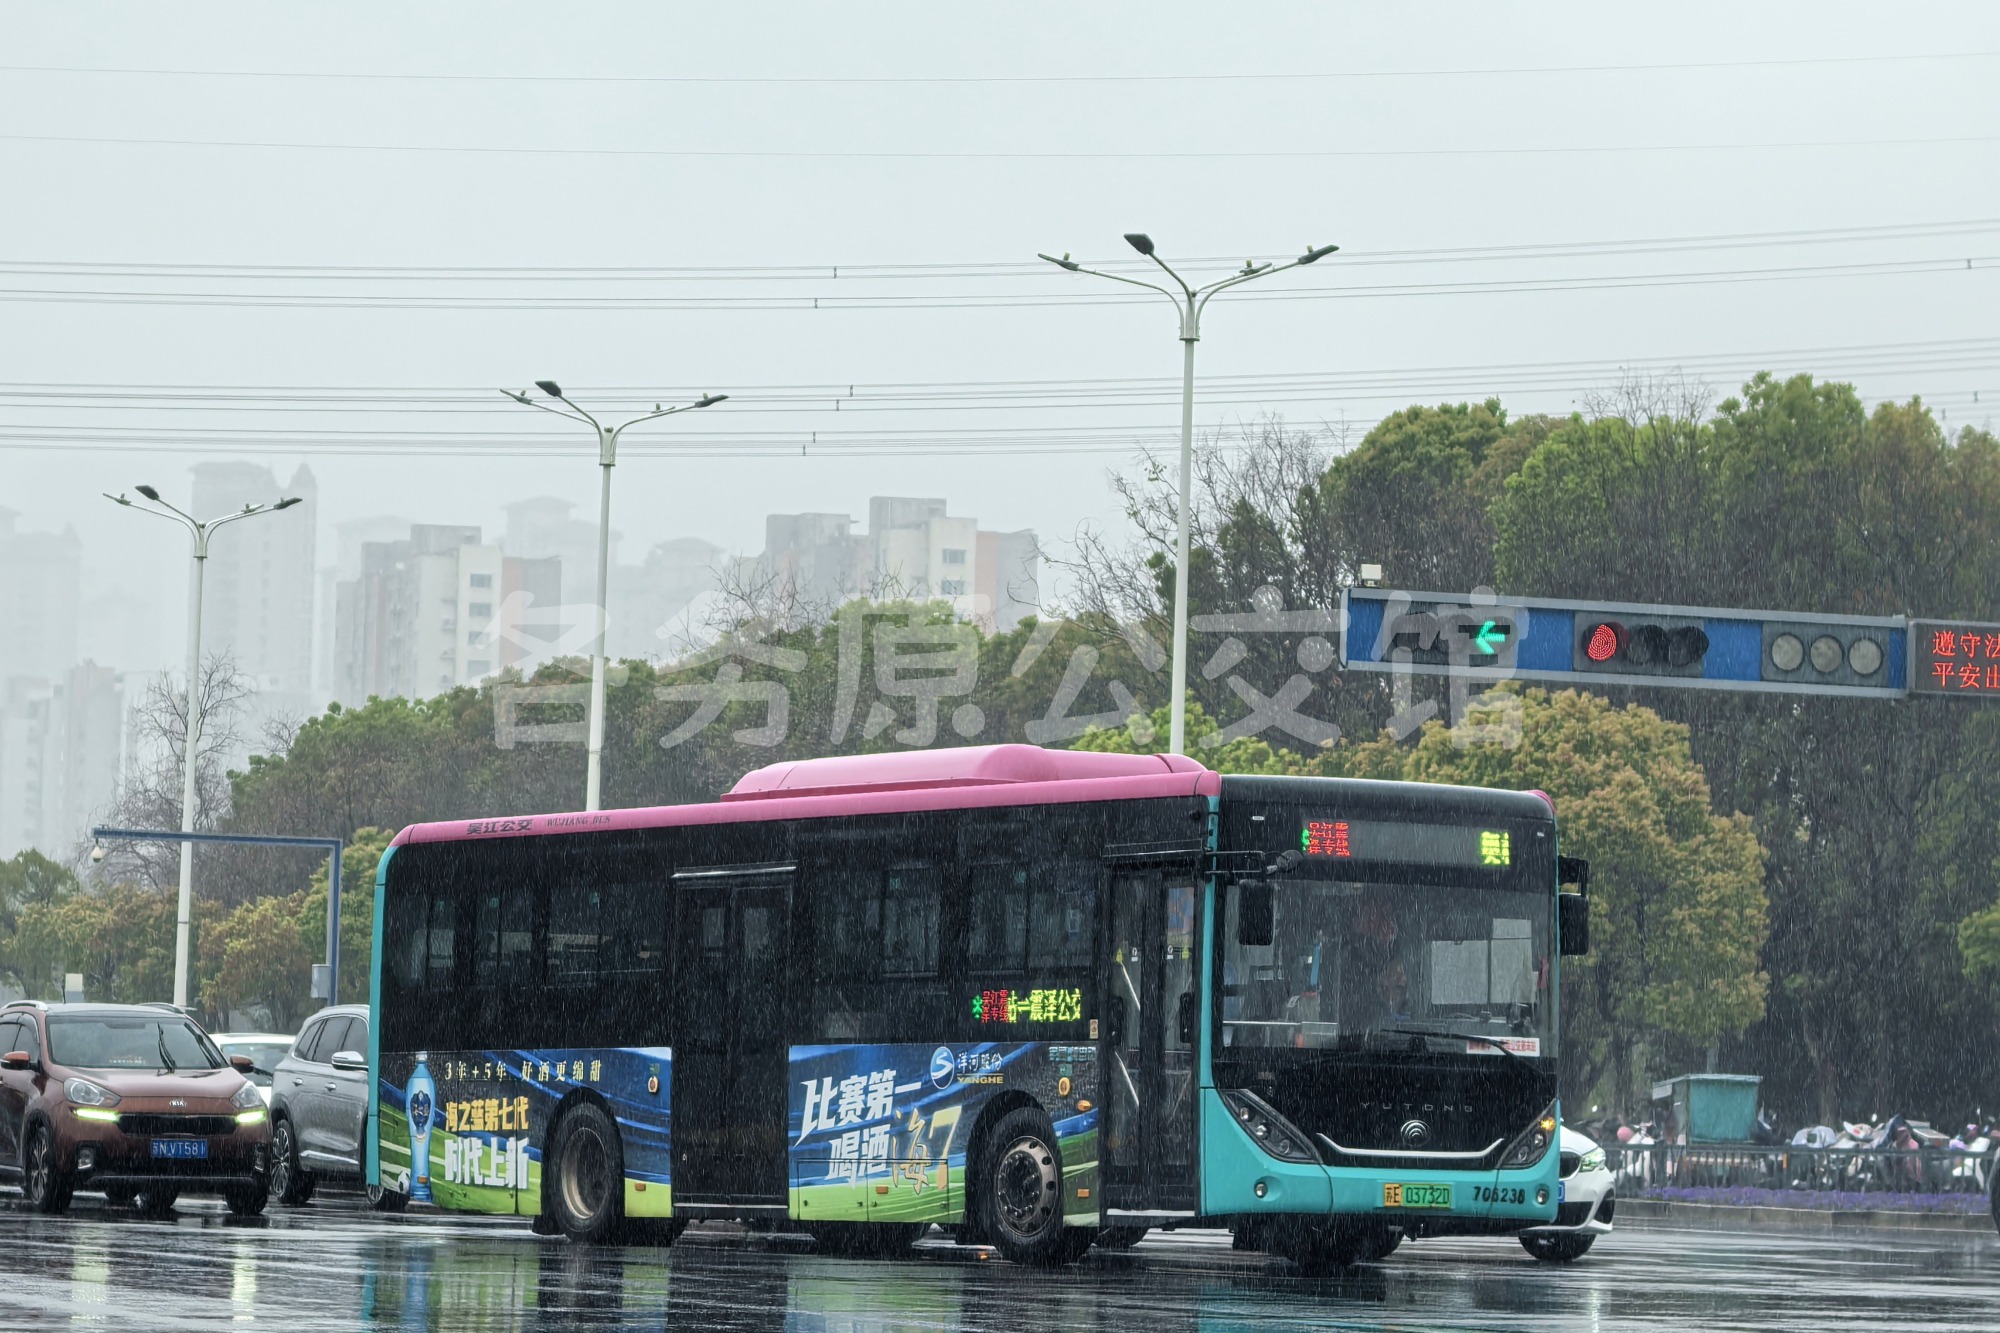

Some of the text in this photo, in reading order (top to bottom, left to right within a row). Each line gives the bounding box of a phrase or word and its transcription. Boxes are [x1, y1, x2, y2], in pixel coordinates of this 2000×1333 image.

[467, 818, 533, 835] 吴江公交
[957, 1053, 1003, 1074] 洋河股份
[956, 1076, 1004, 1085] YANGHE
[170, 1099, 186, 1107] KIA
[794, 1068, 922, 1148] 比赛第一
[1360, 1101, 1473, 1113] YUTONG
[446, 1096, 529, 1131] 海之蓝第七代
[444, 1136, 529, 1190] 时代上新
